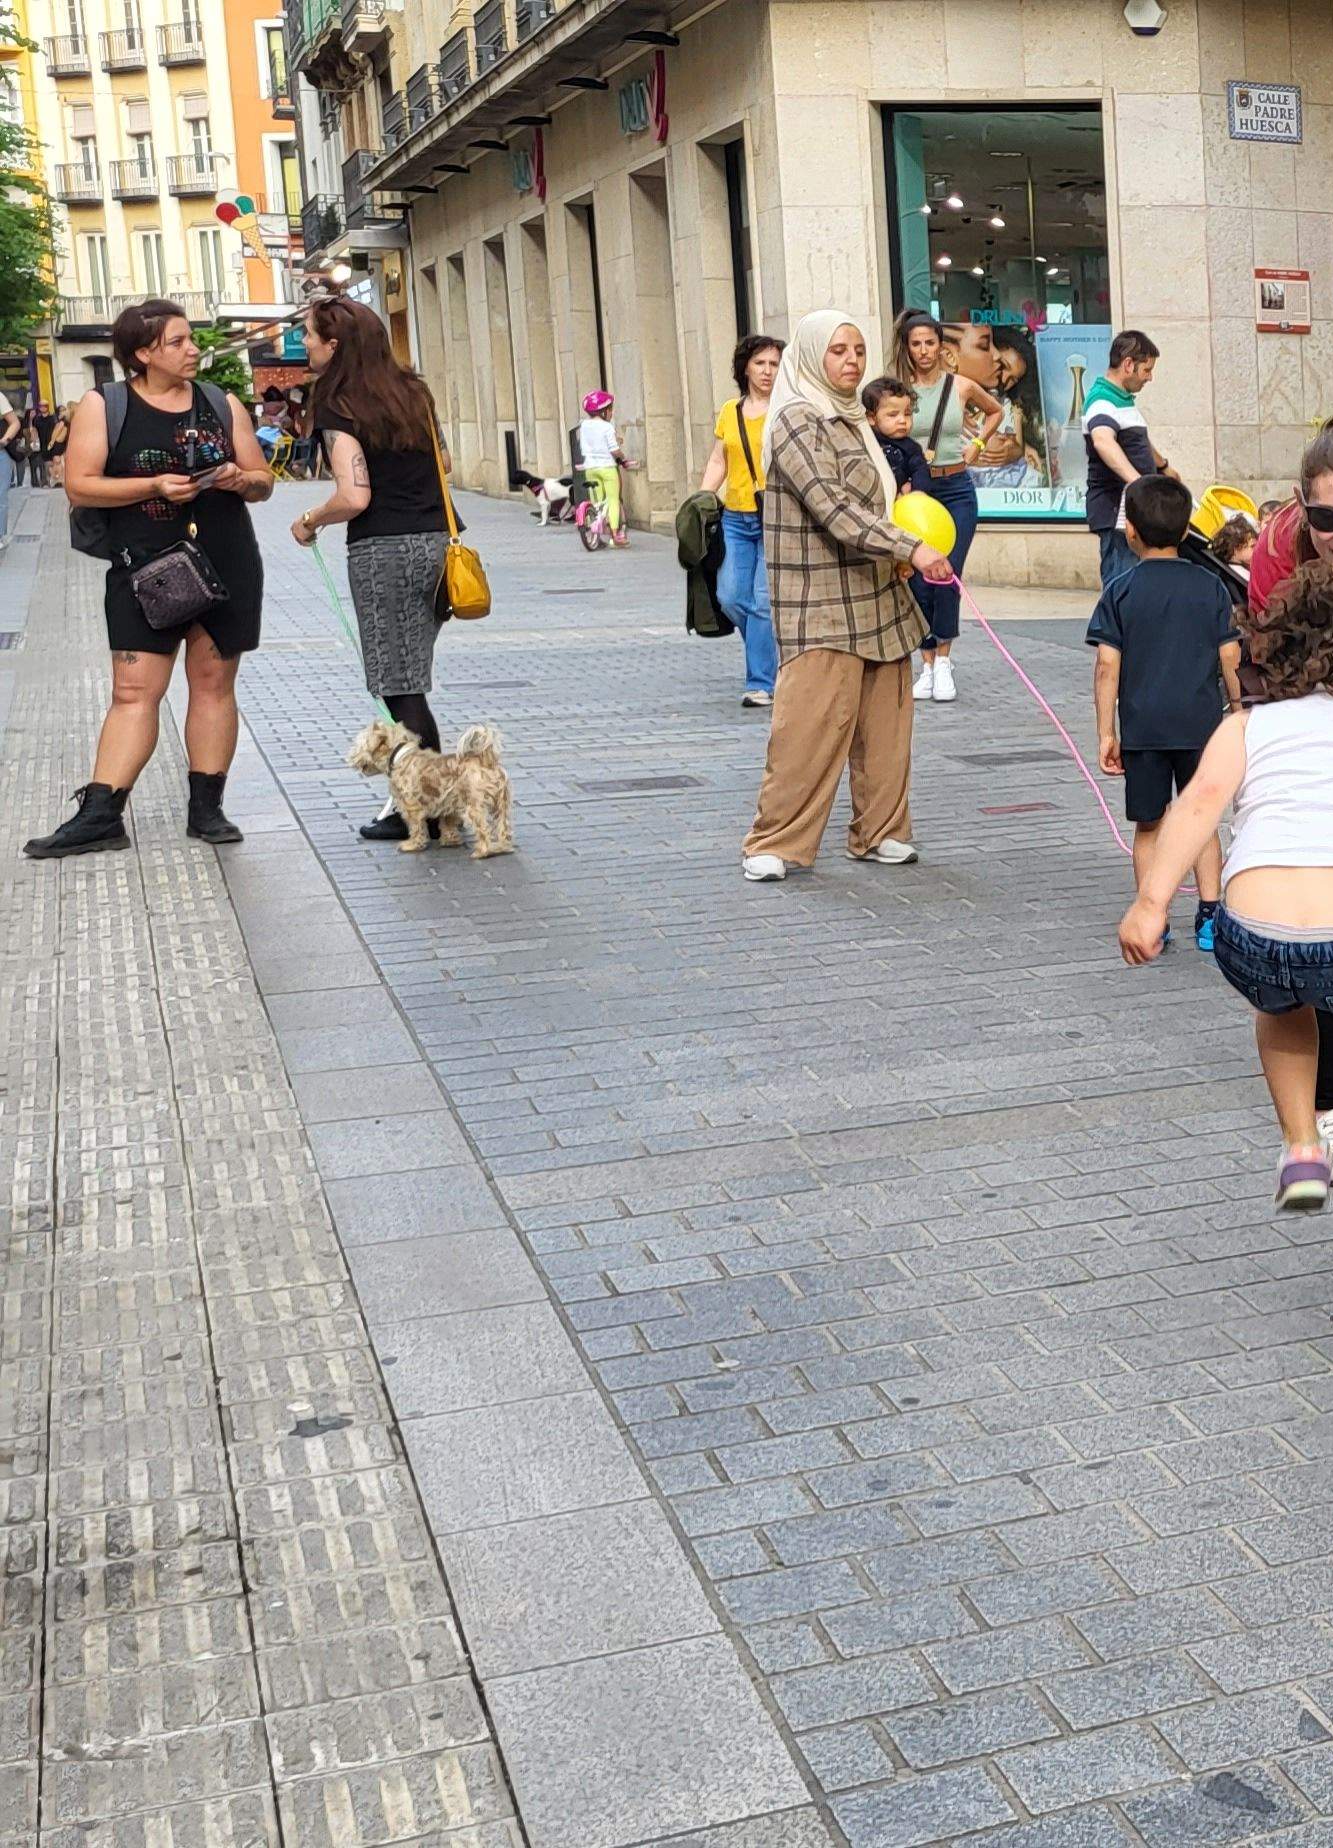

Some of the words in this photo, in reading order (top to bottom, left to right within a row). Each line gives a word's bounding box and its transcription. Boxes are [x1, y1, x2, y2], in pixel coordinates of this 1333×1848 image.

[1258, 93, 1290, 105] CALLE
[1254, 105, 1295, 120] PADRE
[1240, 118, 1292, 133] HUESCA
[1003, 490, 1043, 504] DIOR
